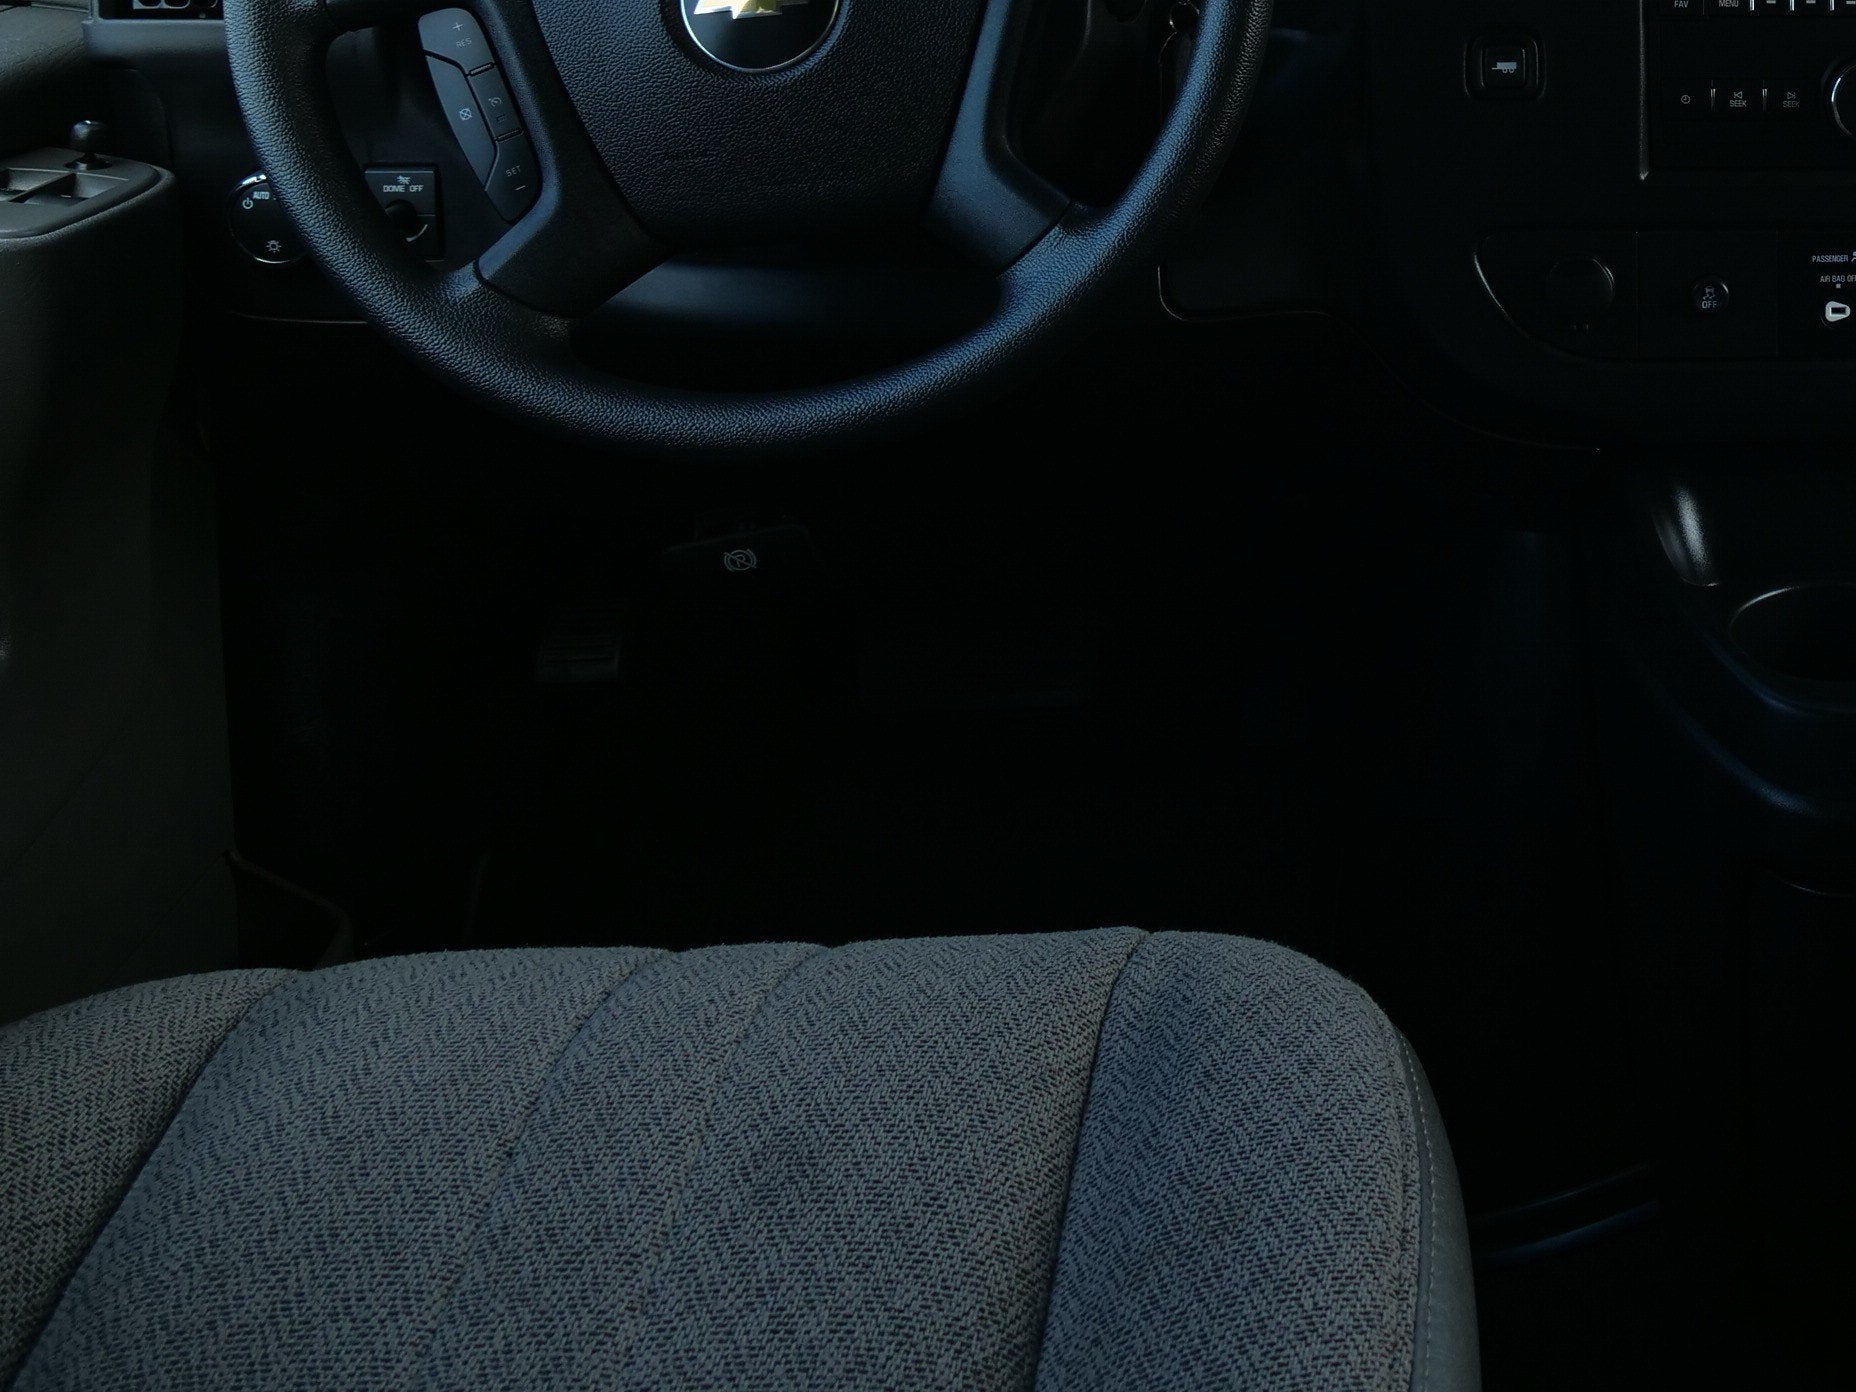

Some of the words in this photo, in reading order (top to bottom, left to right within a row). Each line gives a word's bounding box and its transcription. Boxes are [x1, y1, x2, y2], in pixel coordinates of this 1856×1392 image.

[456, 38, 472, 47] RES
[506, 165, 522, 177] SET
[383, 184, 405, 193] DOME
[408, 184, 424, 193] OFF
[252, 191, 270, 201] AUTO
[1811, 254, 1849, 263] PASSENGER
[1820, 275, 1831, 283] AIR
[1832, 275, 1846, 283] BAG
[1702, 299, 1717, 308] OFF
